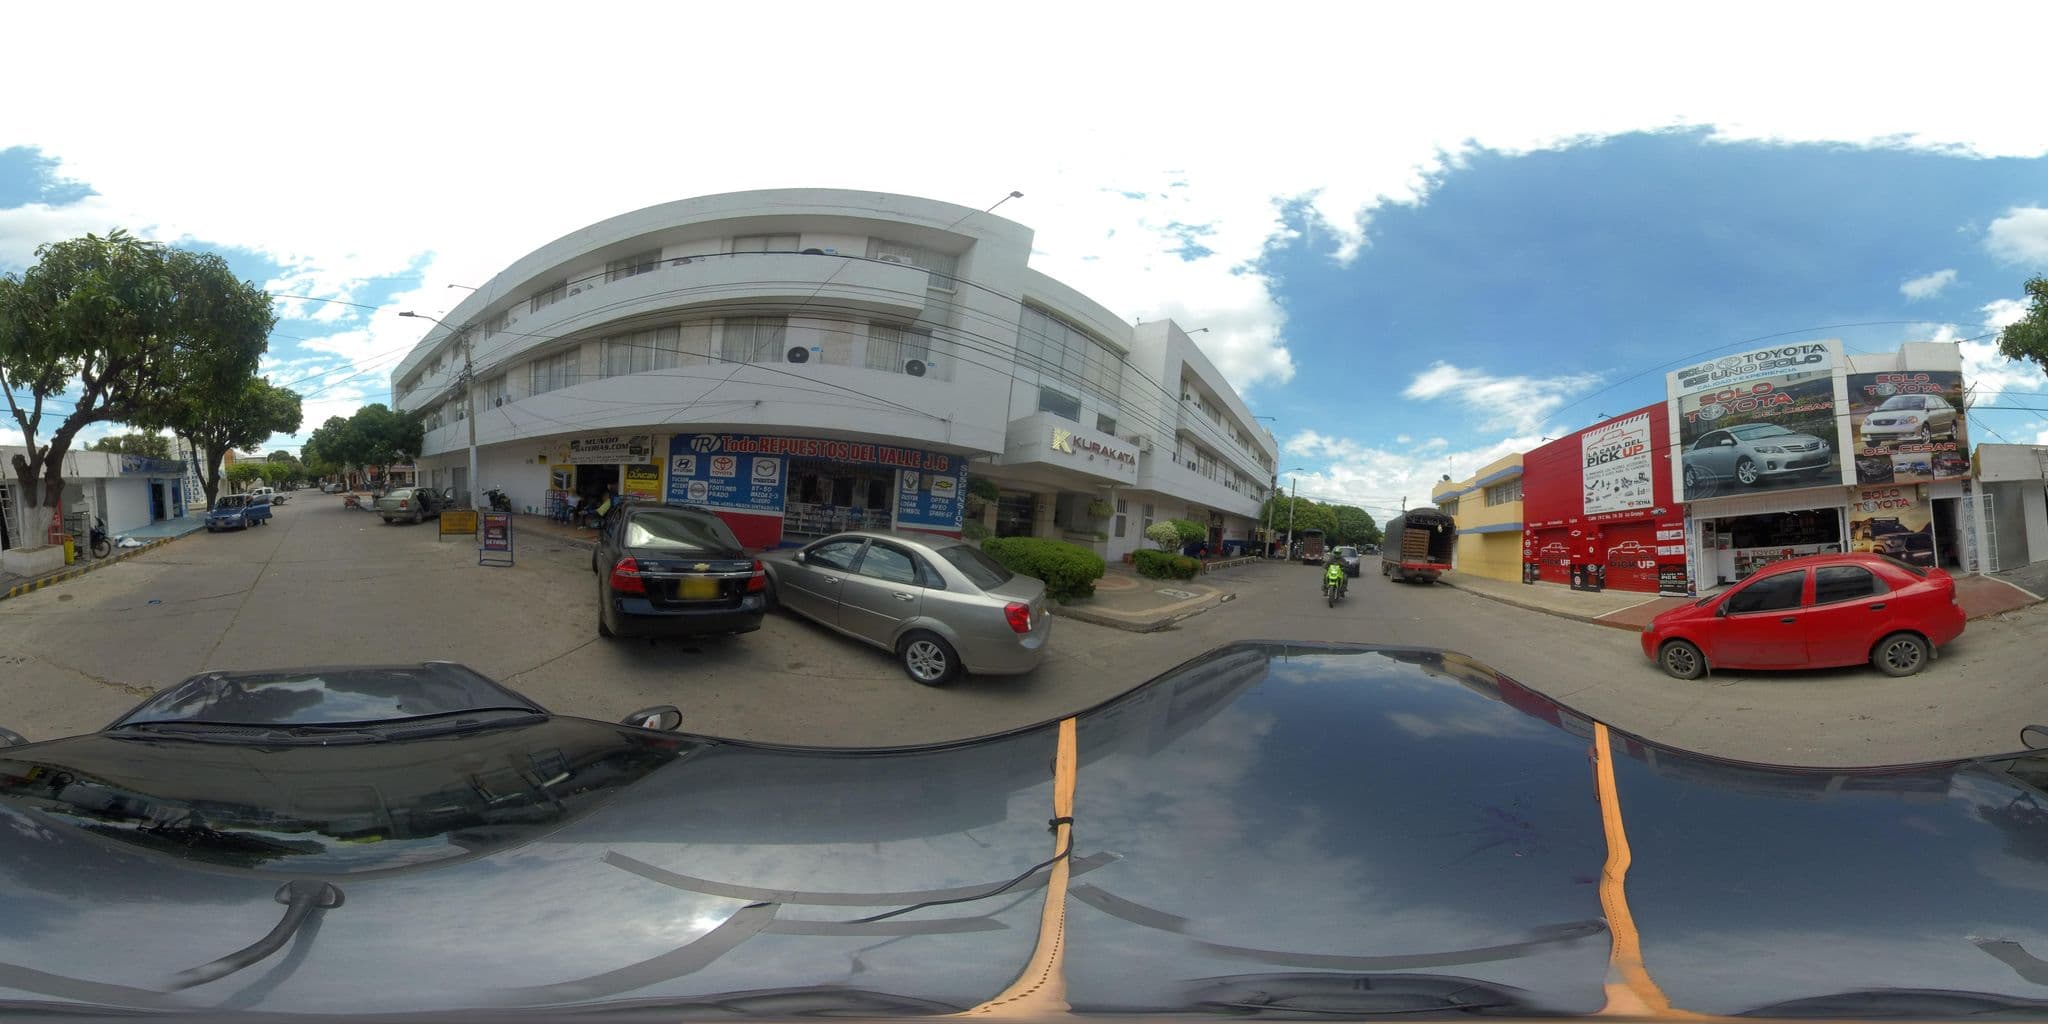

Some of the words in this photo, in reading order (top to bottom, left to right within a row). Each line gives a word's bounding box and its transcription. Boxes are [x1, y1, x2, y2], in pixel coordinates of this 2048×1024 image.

[1677, 363, 1714, 380] SOLO
[1743, 344, 1827, 363] TOYOTA
[1683, 373, 1709, 388] ES
[1711, 364, 1757, 381] UNO
[1759, 354, 1822, 372] SOLO
[1697, 378, 1732, 391] CALIDAD
[1738, 368, 1797, 382] EXPERIENCIA
[1863, 383, 1943, 396] TOYOTA
[1876, 373, 1930, 384] SOLO
[1699, 382, 1774, 406] SOLO
[1684, 392, 1794, 423] TOYOTA
[722, 436, 758, 453] Todo
[758, 436, 849, 459] REPUESTOS
[850, 443, 877, 463] DEL
[878, 446, 921, 469] VALLE
[1073, 435, 1136, 466] KURAKATA
[1587, 450, 1620, 467] PICK
[1622, 444, 1644, 458] UP
[1600, 443, 1623, 454] CASA
[1625, 438, 1643, 448] DEL
[1863, 446, 1897, 457] DEL
[1900, 442, 1957, 454] CESAR
[1853, 498, 1910, 512] TOYOTA
[1861, 488, 1900, 501] SOLO
[1637, 560, 1655, 569] UP
